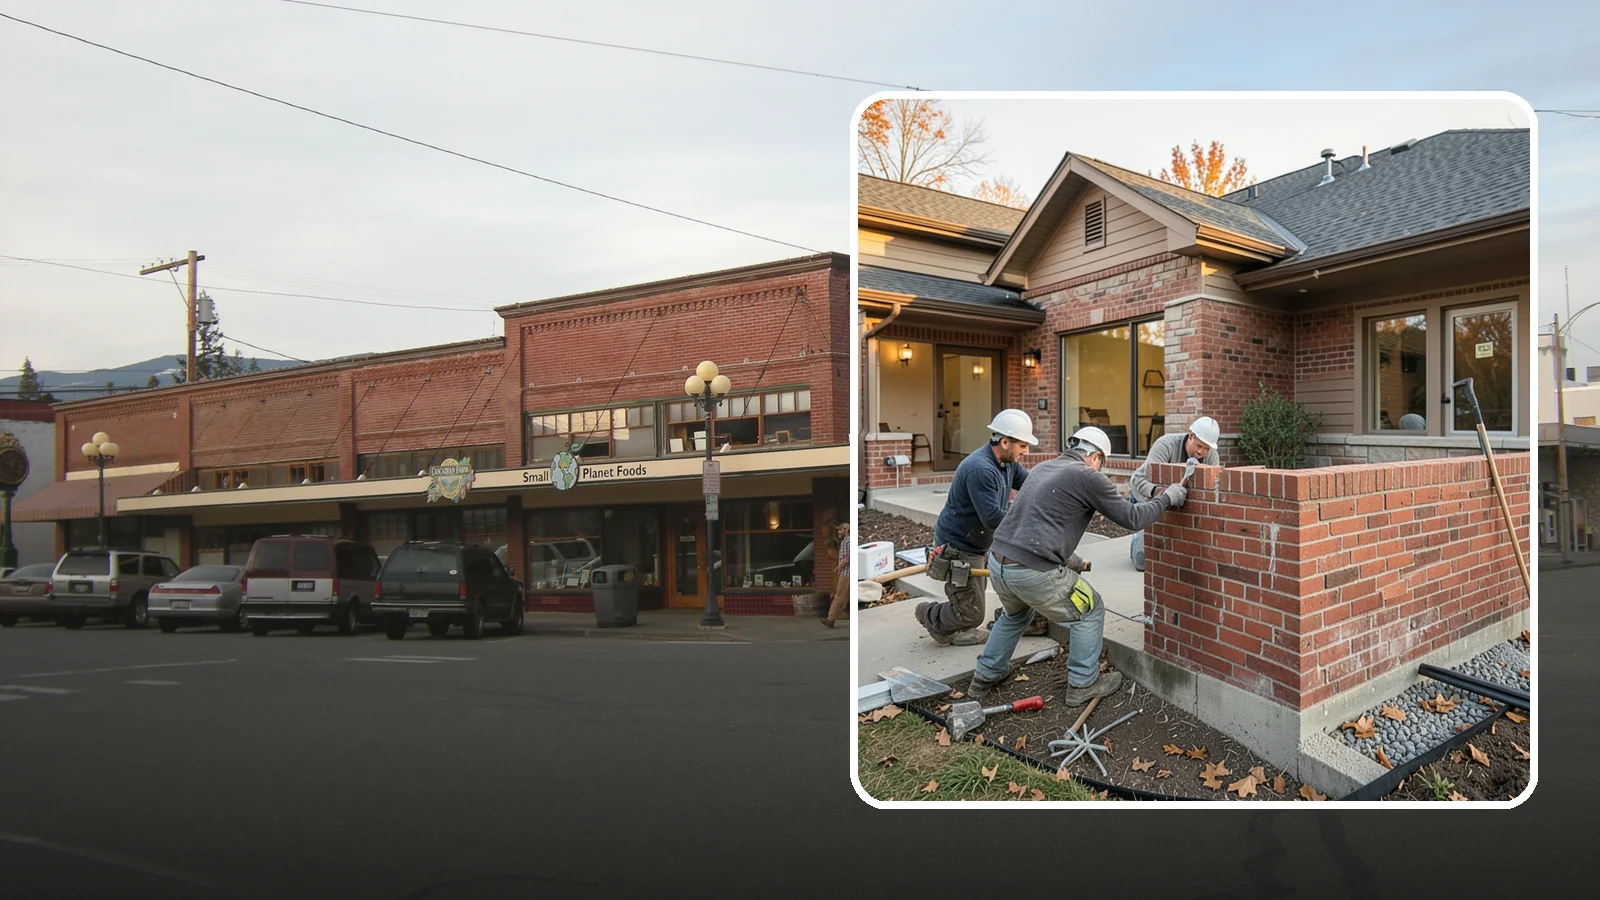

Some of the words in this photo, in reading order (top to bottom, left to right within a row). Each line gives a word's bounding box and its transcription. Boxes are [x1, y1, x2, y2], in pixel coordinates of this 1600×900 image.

[523, 471, 549, 483] Small
[583, 467, 614, 479] Planet
[617, 464, 647, 476] Foods
